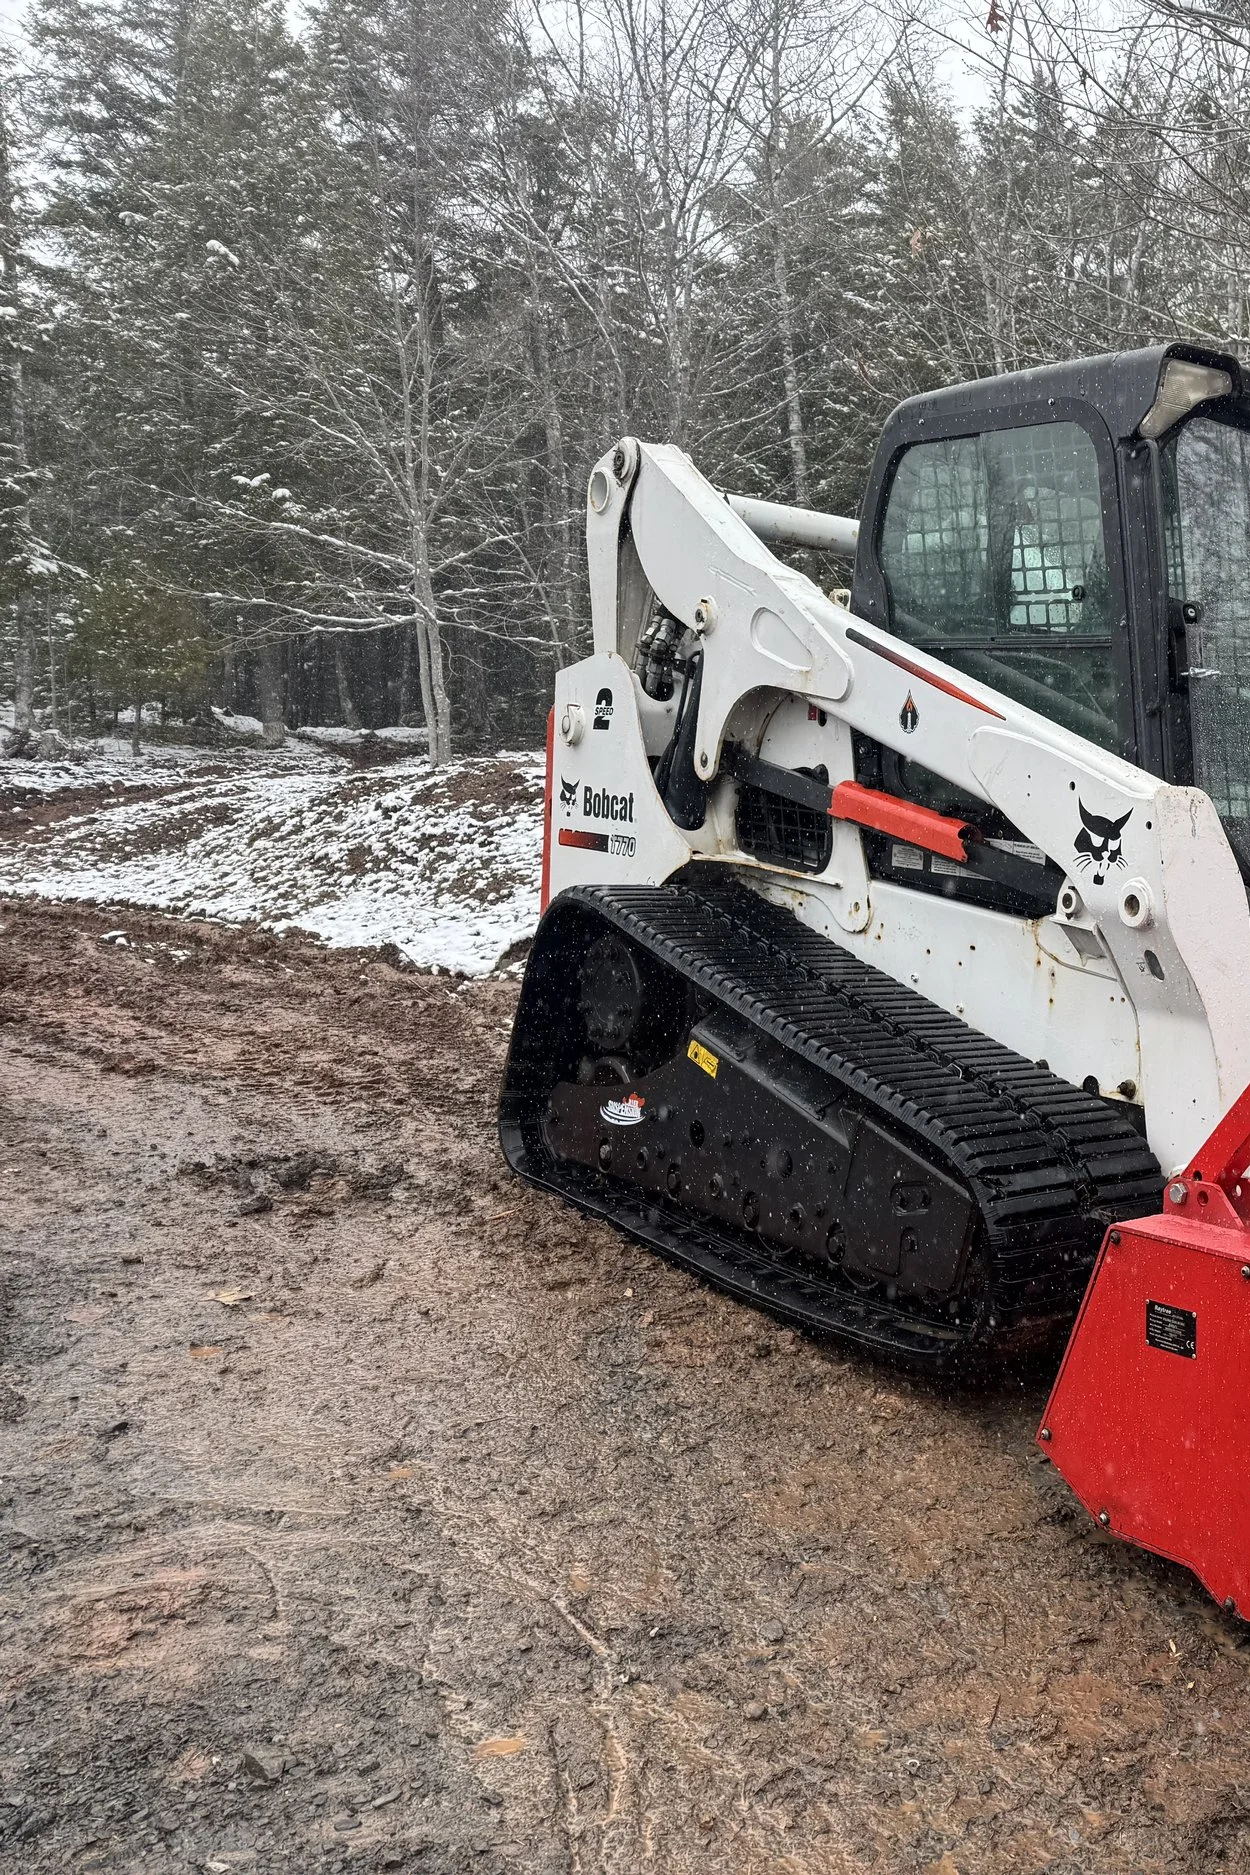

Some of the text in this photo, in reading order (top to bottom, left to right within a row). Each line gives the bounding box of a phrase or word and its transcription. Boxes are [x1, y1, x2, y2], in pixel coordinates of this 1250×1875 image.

[593, 688, 613, 730] 2
[595, 706, 614, 716] SPEED
[583, 785, 634, 823] Bobcat
